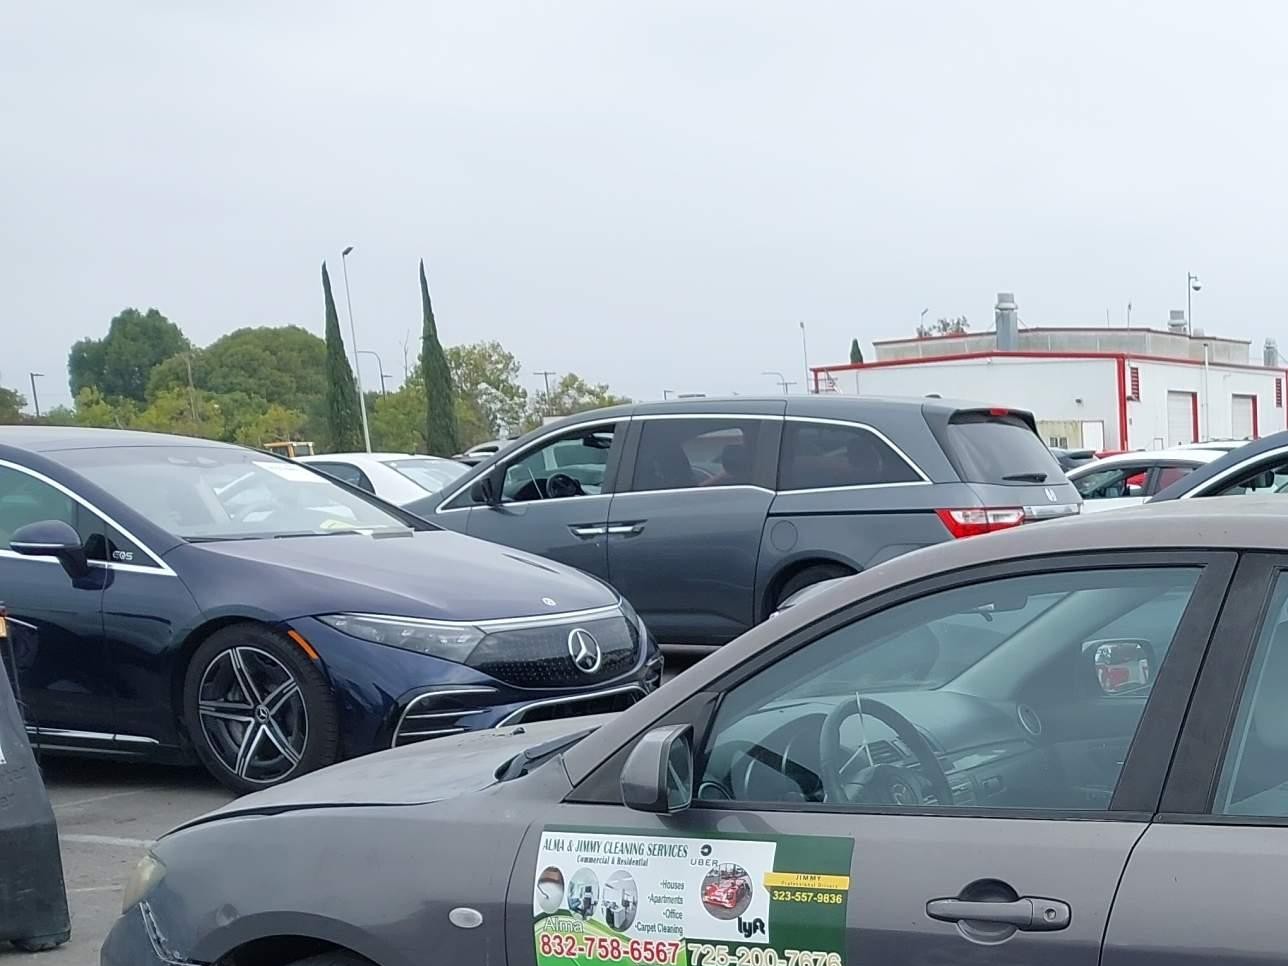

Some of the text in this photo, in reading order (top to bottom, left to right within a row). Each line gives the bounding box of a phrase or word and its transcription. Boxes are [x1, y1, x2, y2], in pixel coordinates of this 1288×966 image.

[543, 839, 689, 858] ALMA & JIMMY CLEANING SERVICES
[577, 855, 610, 865] Commercial
[616, 857, 649, 867] Residential
[690, 858, 719, 867] UBER
[772, 890, 843, 904] 323-557-9836
[543, 916, 585, 934] Alma
[637, 921, 684, 936] Carpet Cleaning
[540, 934, 681, 966] 832-758-6567
